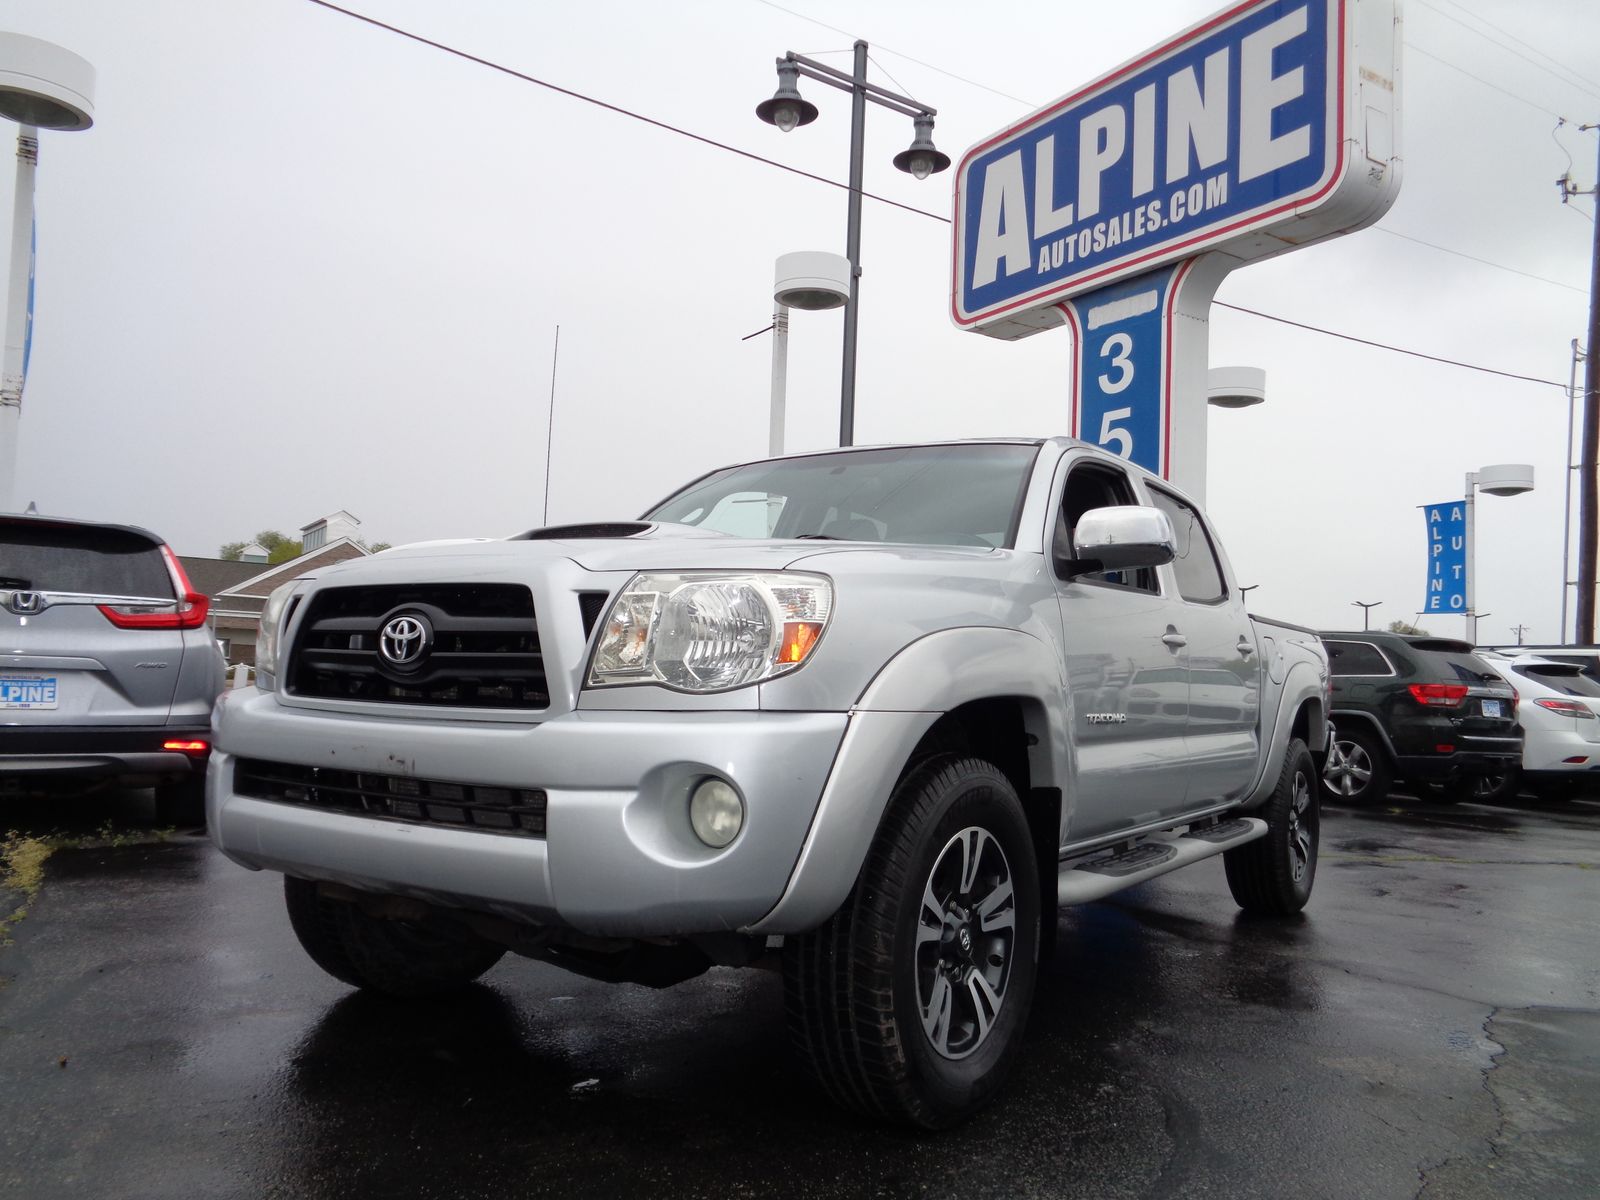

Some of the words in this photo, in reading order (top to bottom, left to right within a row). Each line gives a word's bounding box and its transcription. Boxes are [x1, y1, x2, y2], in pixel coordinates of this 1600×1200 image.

[972, 5, 1310, 290] ALPINE
[1038, 172, 1228, 274] AUTOSALES.COM
[1430, 509, 1443, 609] ALPINE
[1450, 507, 1463, 609] AUTO
[1086, 712, 1127, 723] TACOMA
